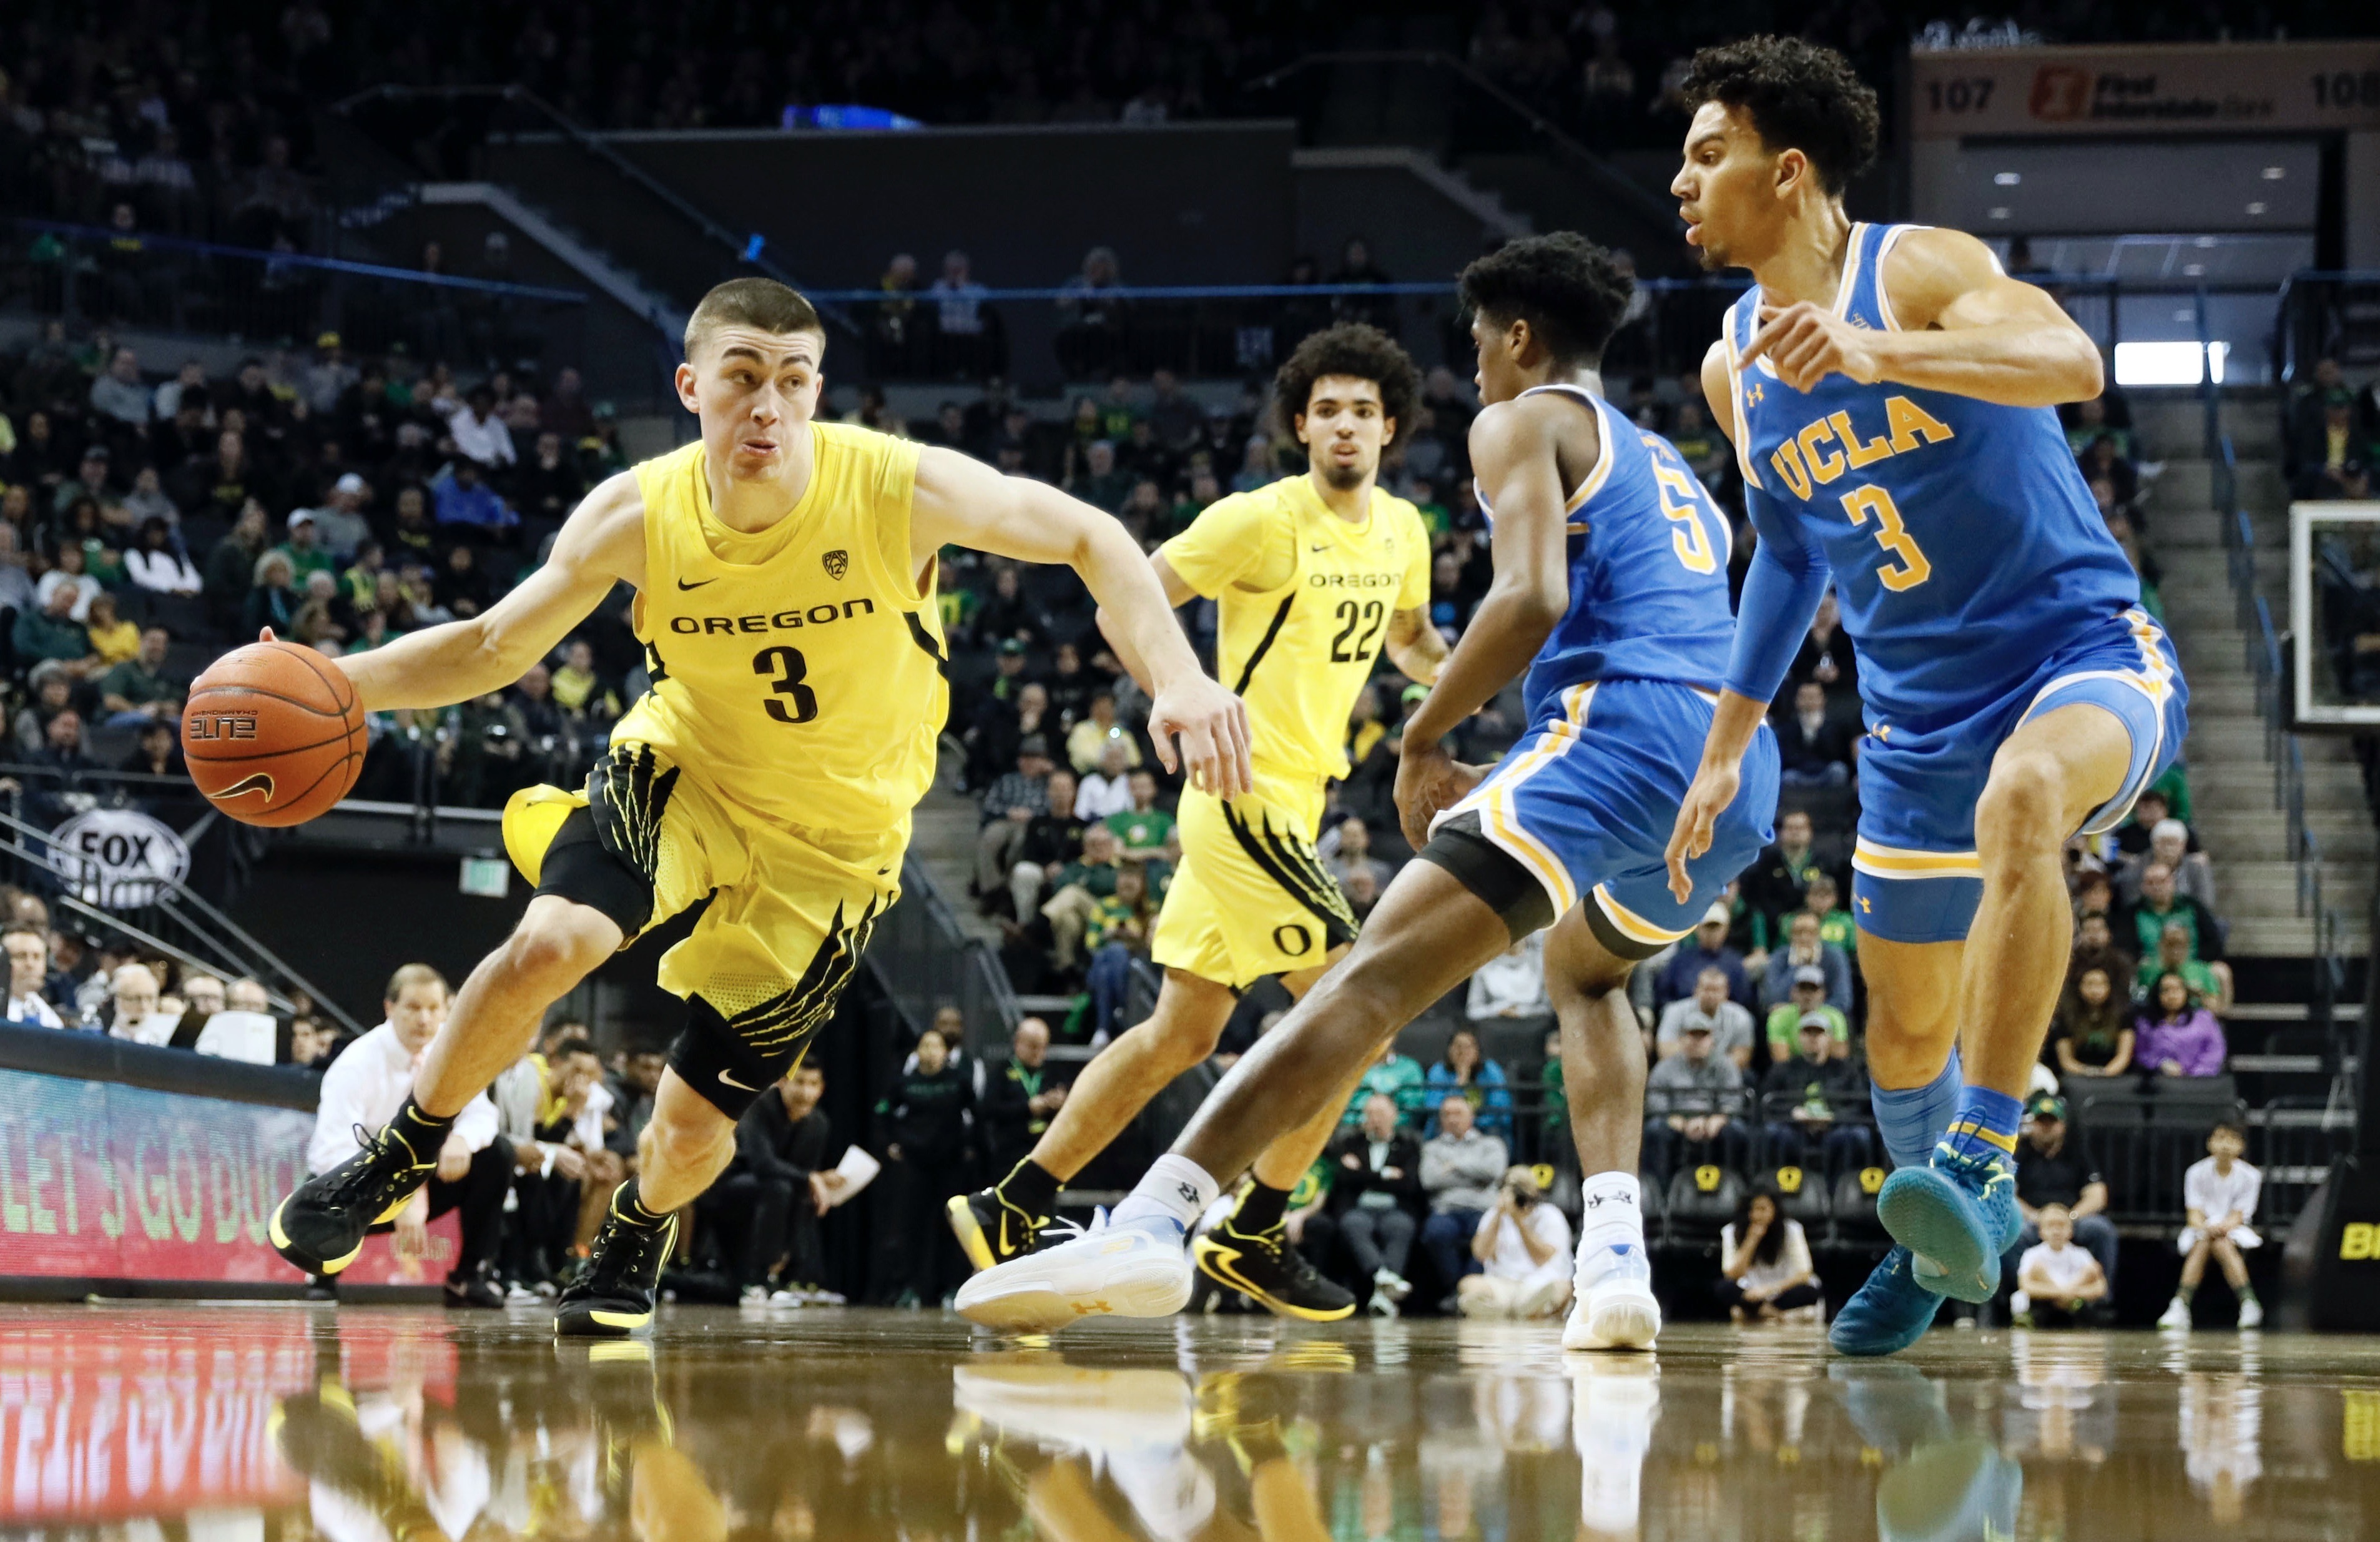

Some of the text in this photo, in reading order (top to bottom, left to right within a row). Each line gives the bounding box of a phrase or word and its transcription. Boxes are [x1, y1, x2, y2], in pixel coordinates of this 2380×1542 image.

[1928, 79, 1995, 112] 107
[1770, 396, 1955, 502] UCLA
[1651, 451, 1717, 575] 5
[1839, 483, 1931, 592] 3
[824, 551, 847, 571] PAC
[830, 563, 843, 575] 12
[1310, 573, 1402, 588] OREGON
[671, 598, 874, 635] OREGON
[1330, 600, 1384, 663] 22
[752, 646, 818, 723] 3
[190, 717, 257, 741] ELITE
[80, 831, 152, 869] FOX
[1272, 924, 1312, 956] O
[134, 1122, 203, 1243] GO
